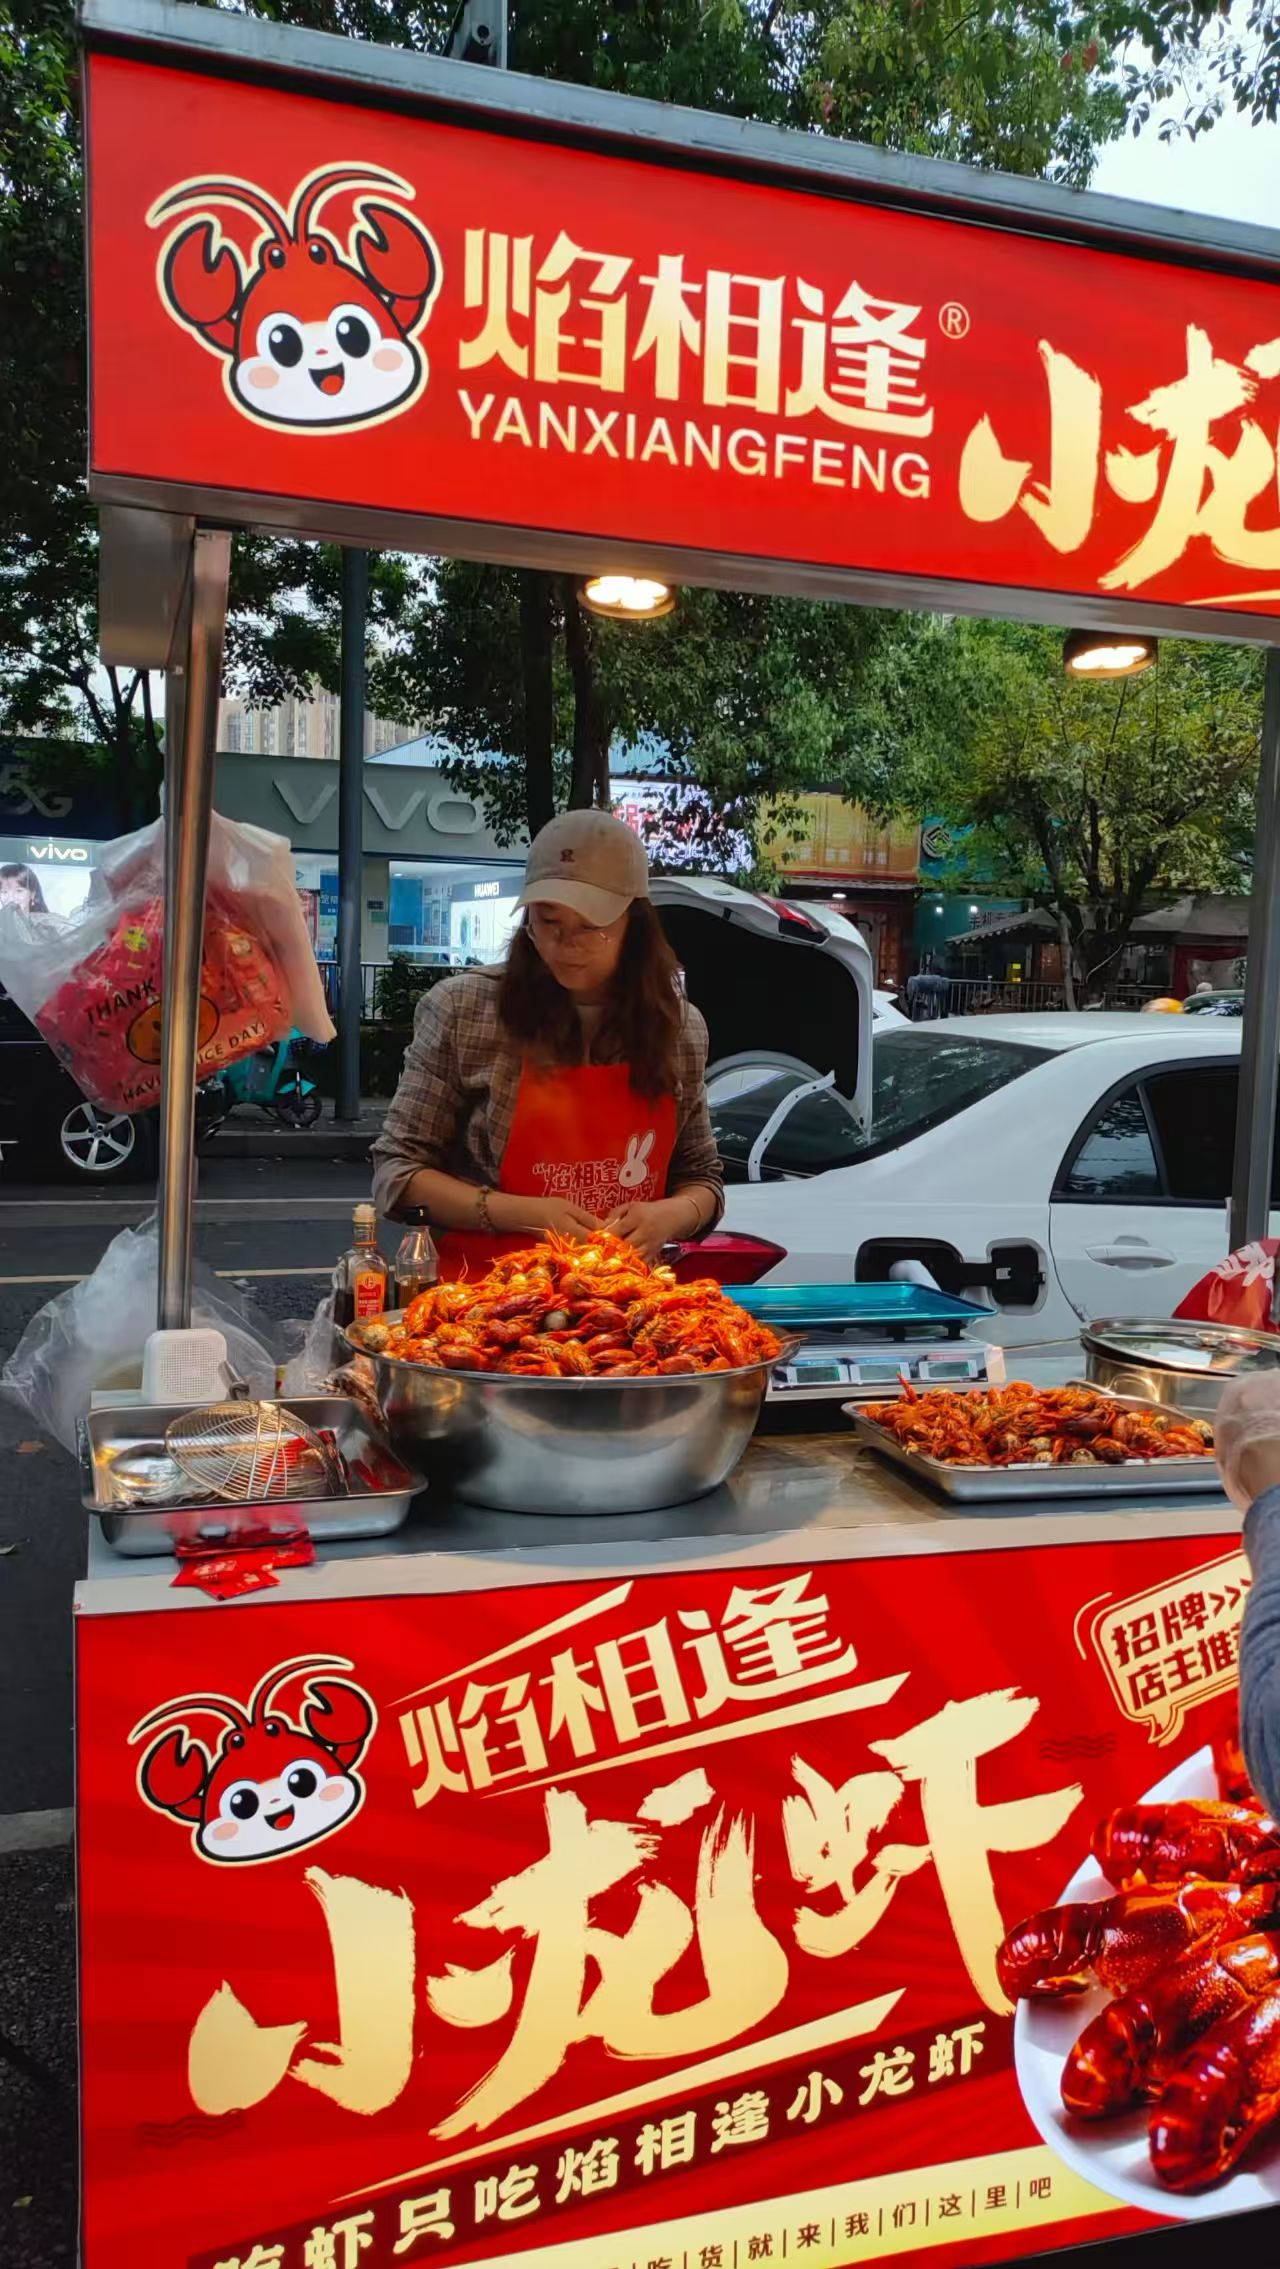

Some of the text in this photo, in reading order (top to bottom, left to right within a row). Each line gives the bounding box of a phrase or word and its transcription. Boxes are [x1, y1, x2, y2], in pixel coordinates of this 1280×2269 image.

[458, 228, 934, 438] 焰相逢
[457, 390, 931, 499] YANXIANGFENG
[273, 779, 484, 835] vvo
[30, 843, 88, 861] vivo
[474, 881, 500, 898] HUAWEI
[84, 978, 157, 1024] THANK
[122, 1078, 161, 1103] HAV
[197, 1043, 223, 1065] ICE
[399, 1571, 858, 1809] 焰相逢
[1127, 1623, 1241, 1711] 店主推
[187, 1688, 1084, 2138] 小龙虾
